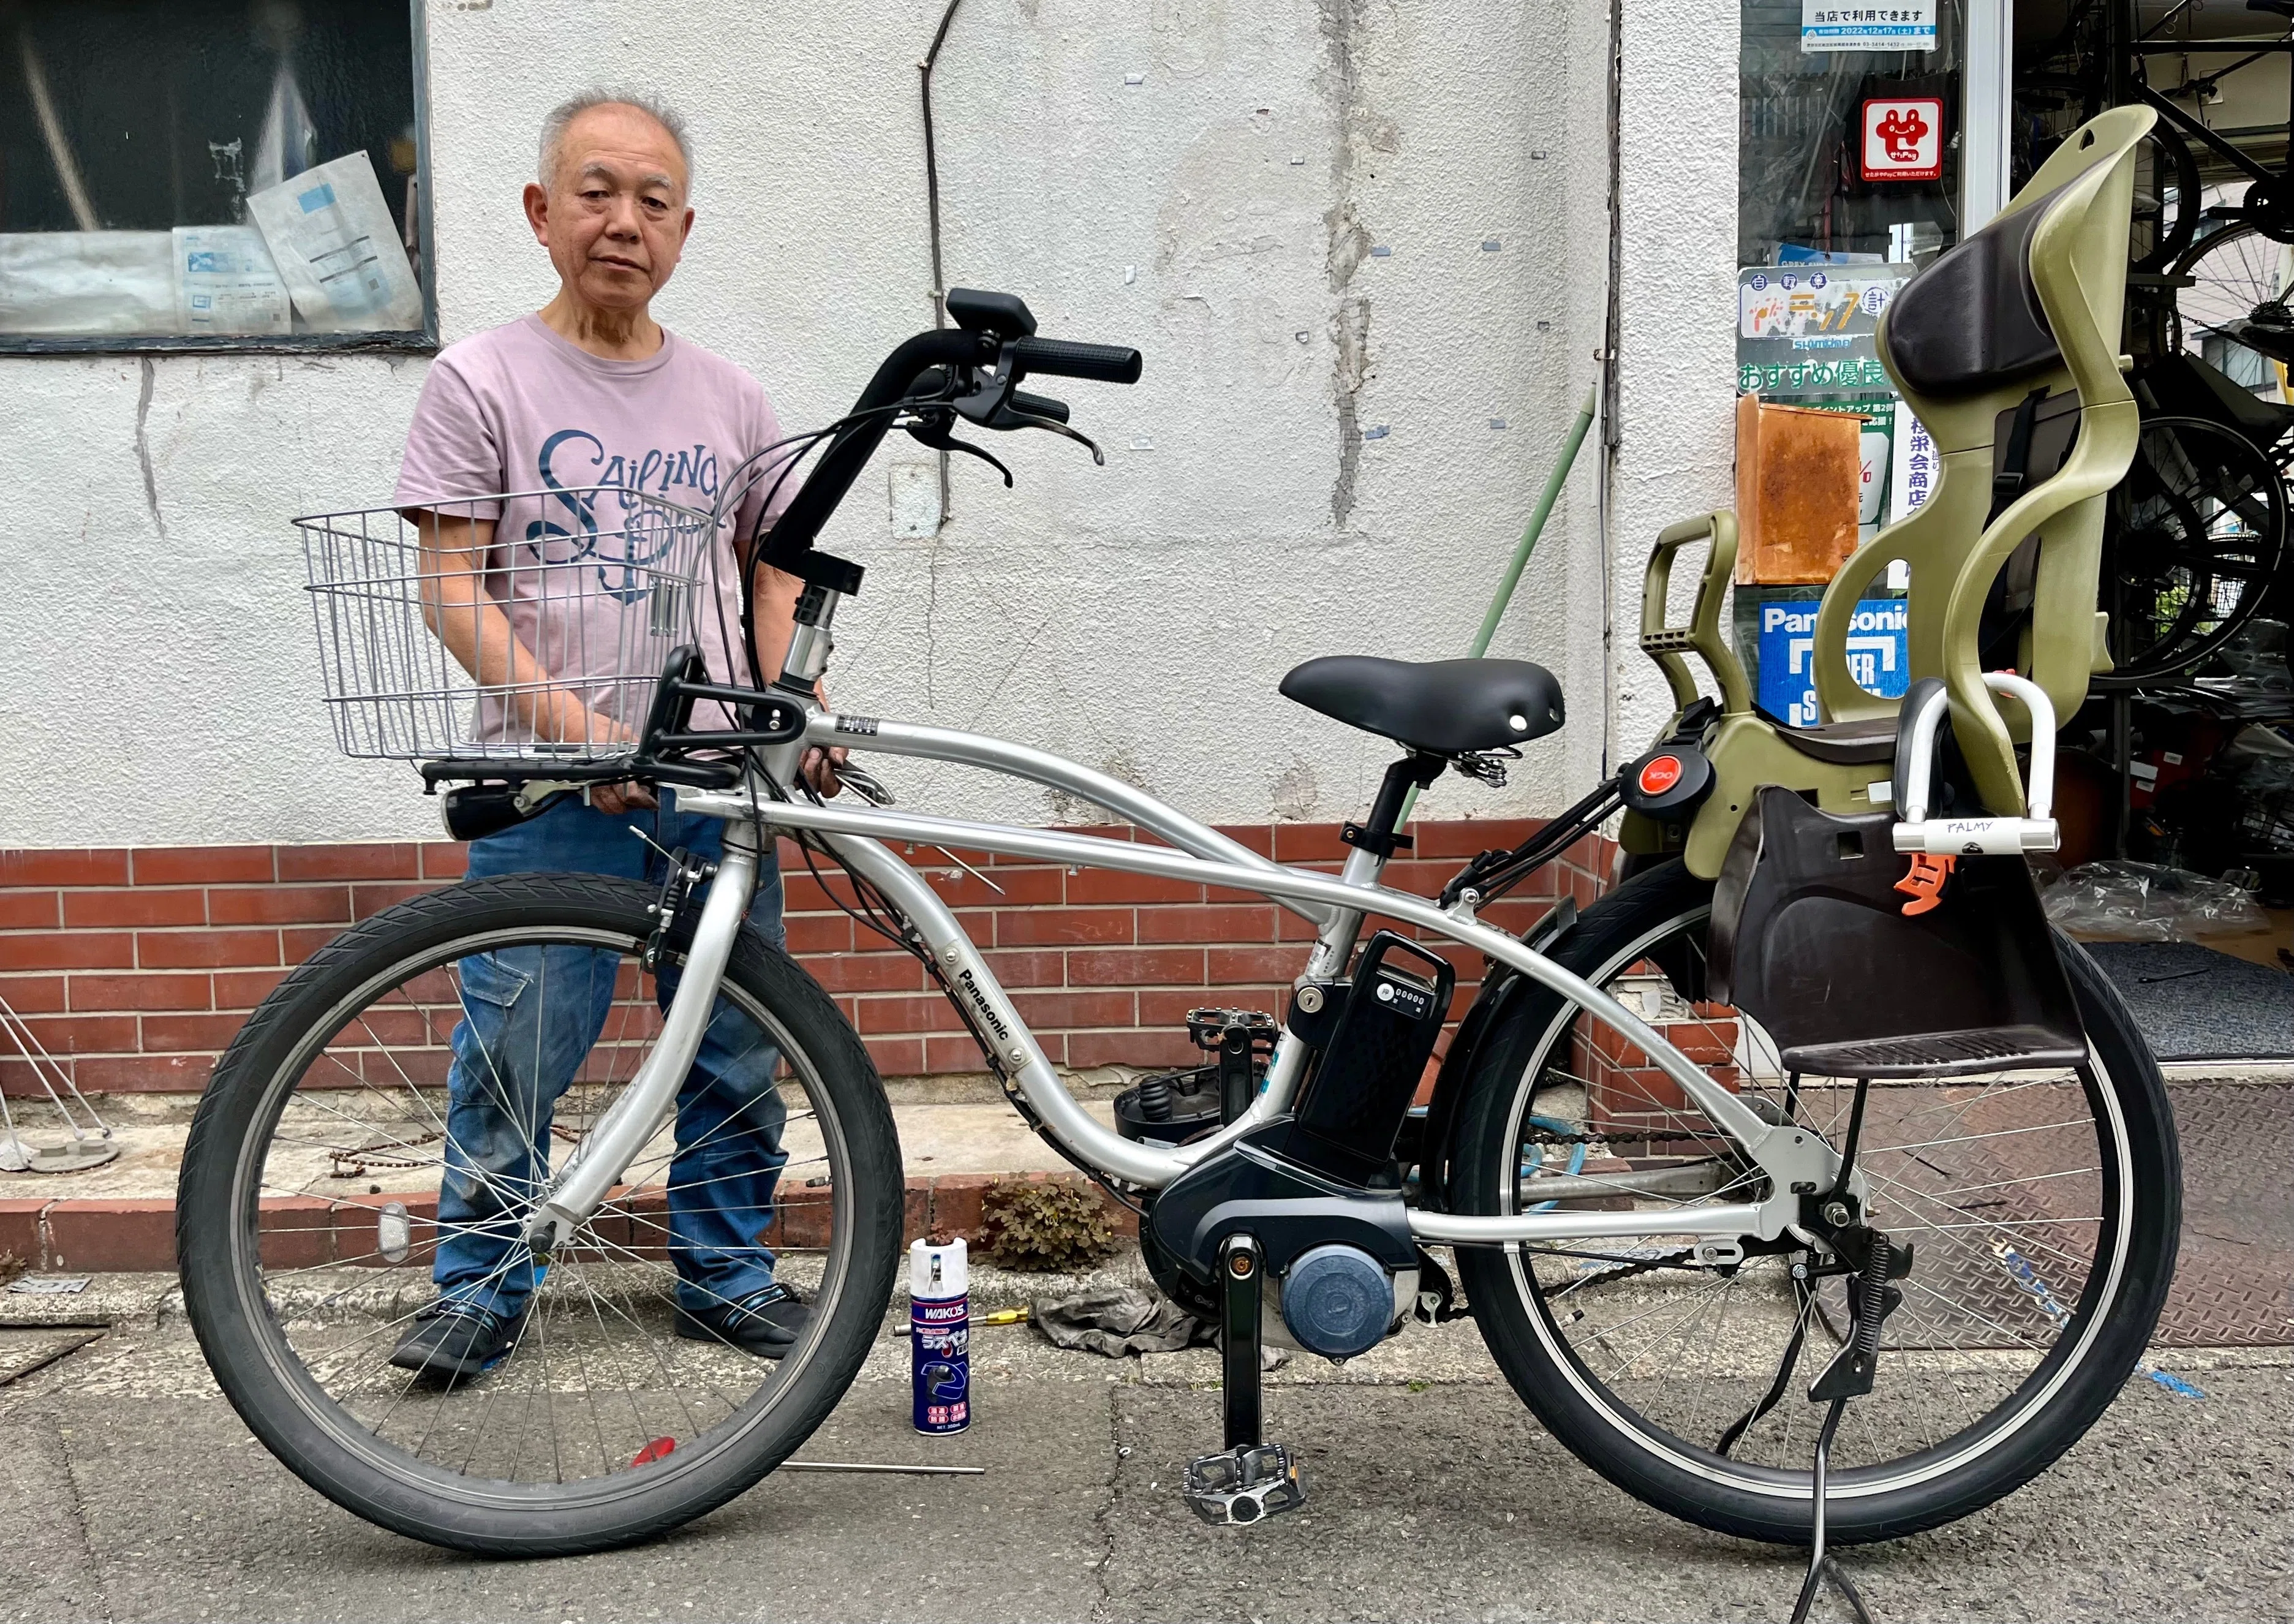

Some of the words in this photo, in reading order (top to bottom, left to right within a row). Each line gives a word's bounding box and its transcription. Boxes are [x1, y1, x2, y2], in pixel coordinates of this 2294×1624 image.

[1815, 10, 1923, 22] 当店で利用できます
[1738, 360, 1892, 390] おすすめ優良
[1947, 821, 1994, 833] PALMY
[958, 968, 1009, 1041] Panasonic
